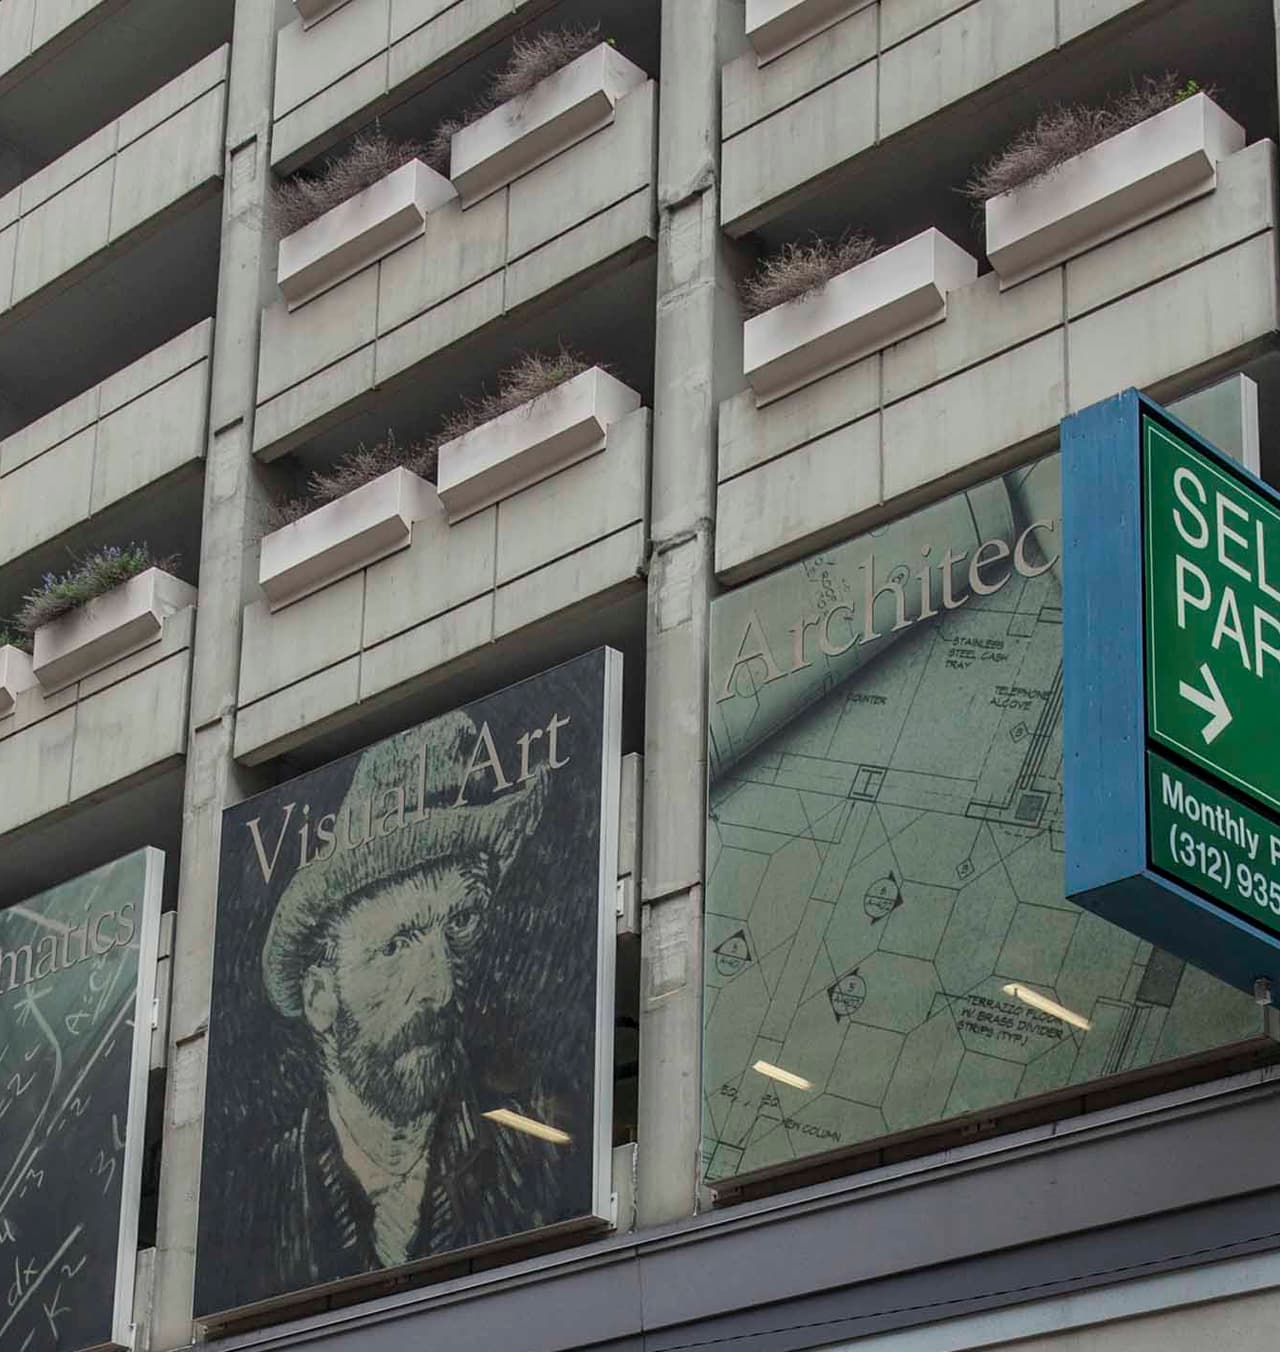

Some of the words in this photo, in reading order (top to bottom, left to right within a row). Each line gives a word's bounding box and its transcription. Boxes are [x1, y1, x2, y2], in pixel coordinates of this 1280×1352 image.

[715, 519, 1062, 704] Architec
[246, 743, 431, 885] Visual
[452, 711, 572, 808] Art
[1162, 774, 1260, 858] Monthly
[1169, 823, 1232, 891] (312)
